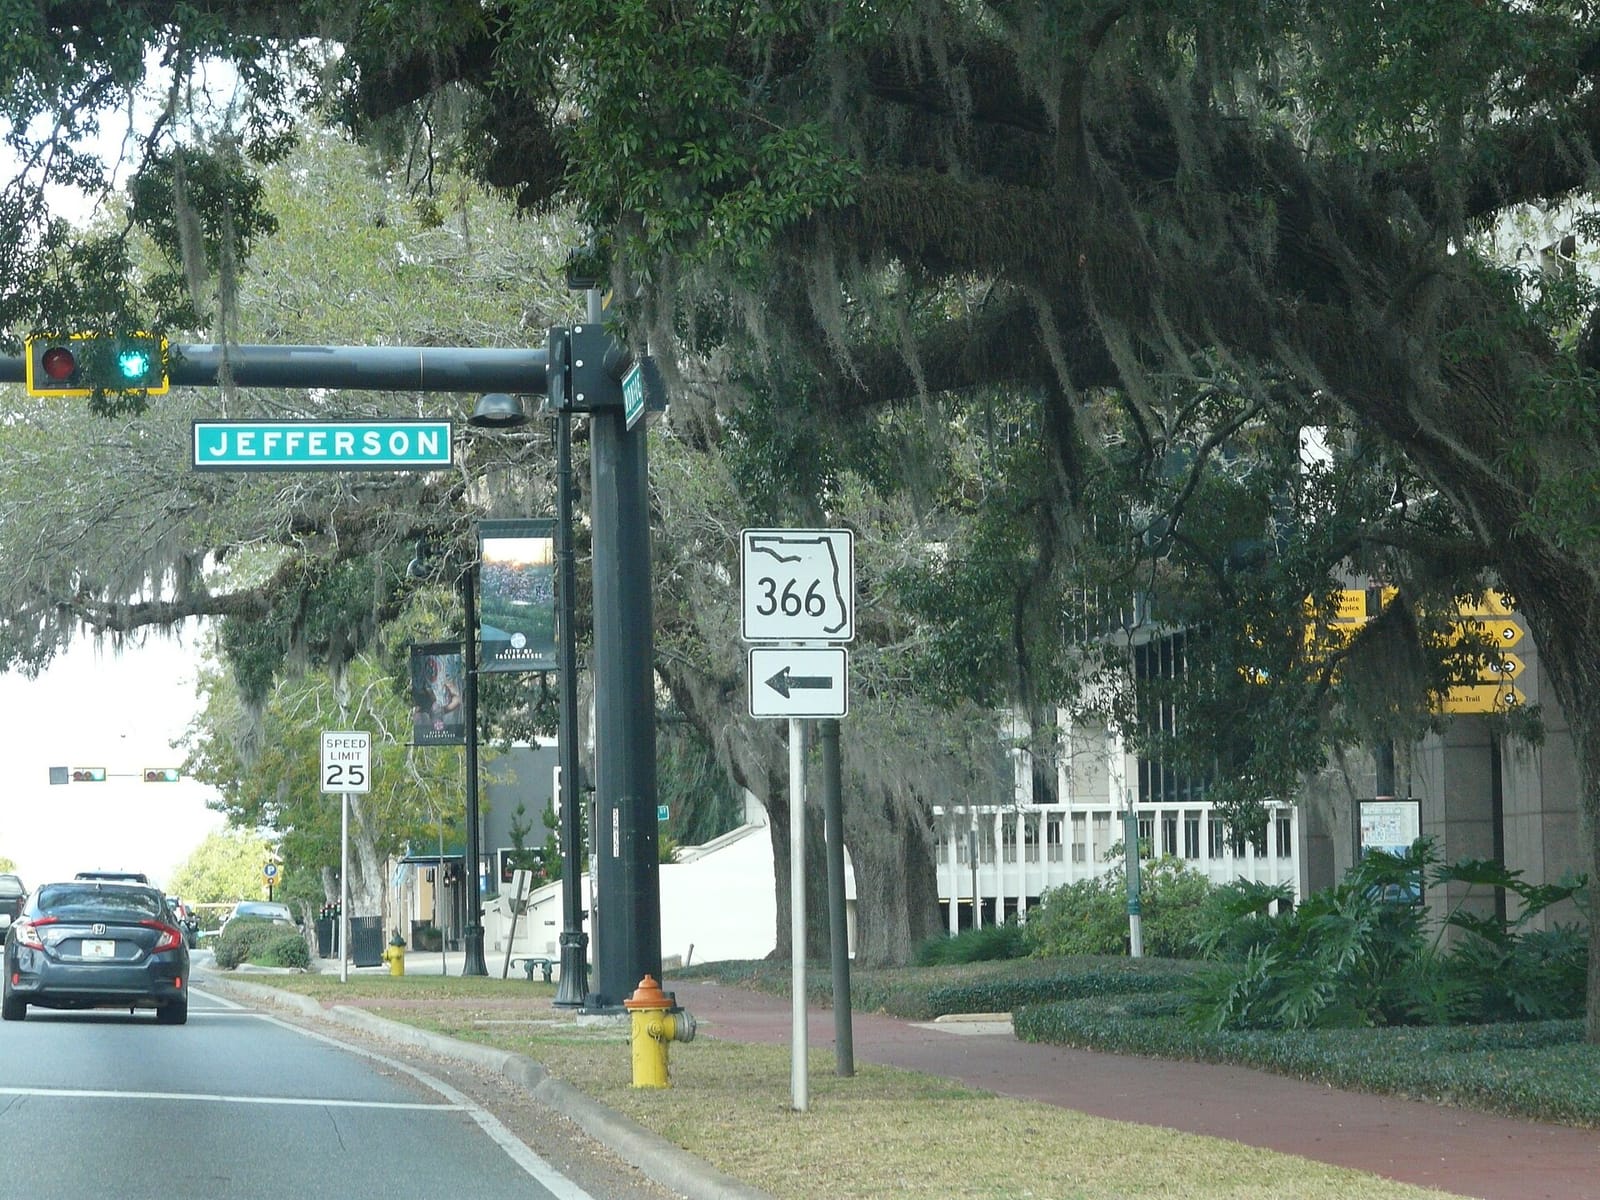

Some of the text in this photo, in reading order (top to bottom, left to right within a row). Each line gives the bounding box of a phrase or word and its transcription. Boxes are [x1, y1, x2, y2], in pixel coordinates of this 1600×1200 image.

[208, 431, 439, 457] JEFFERSON
[756, 577, 826, 617] 366
[326, 738, 367, 748] SPEED
[330, 751, 361, 761] LIMIT
[326, 764, 365, 785] 25
